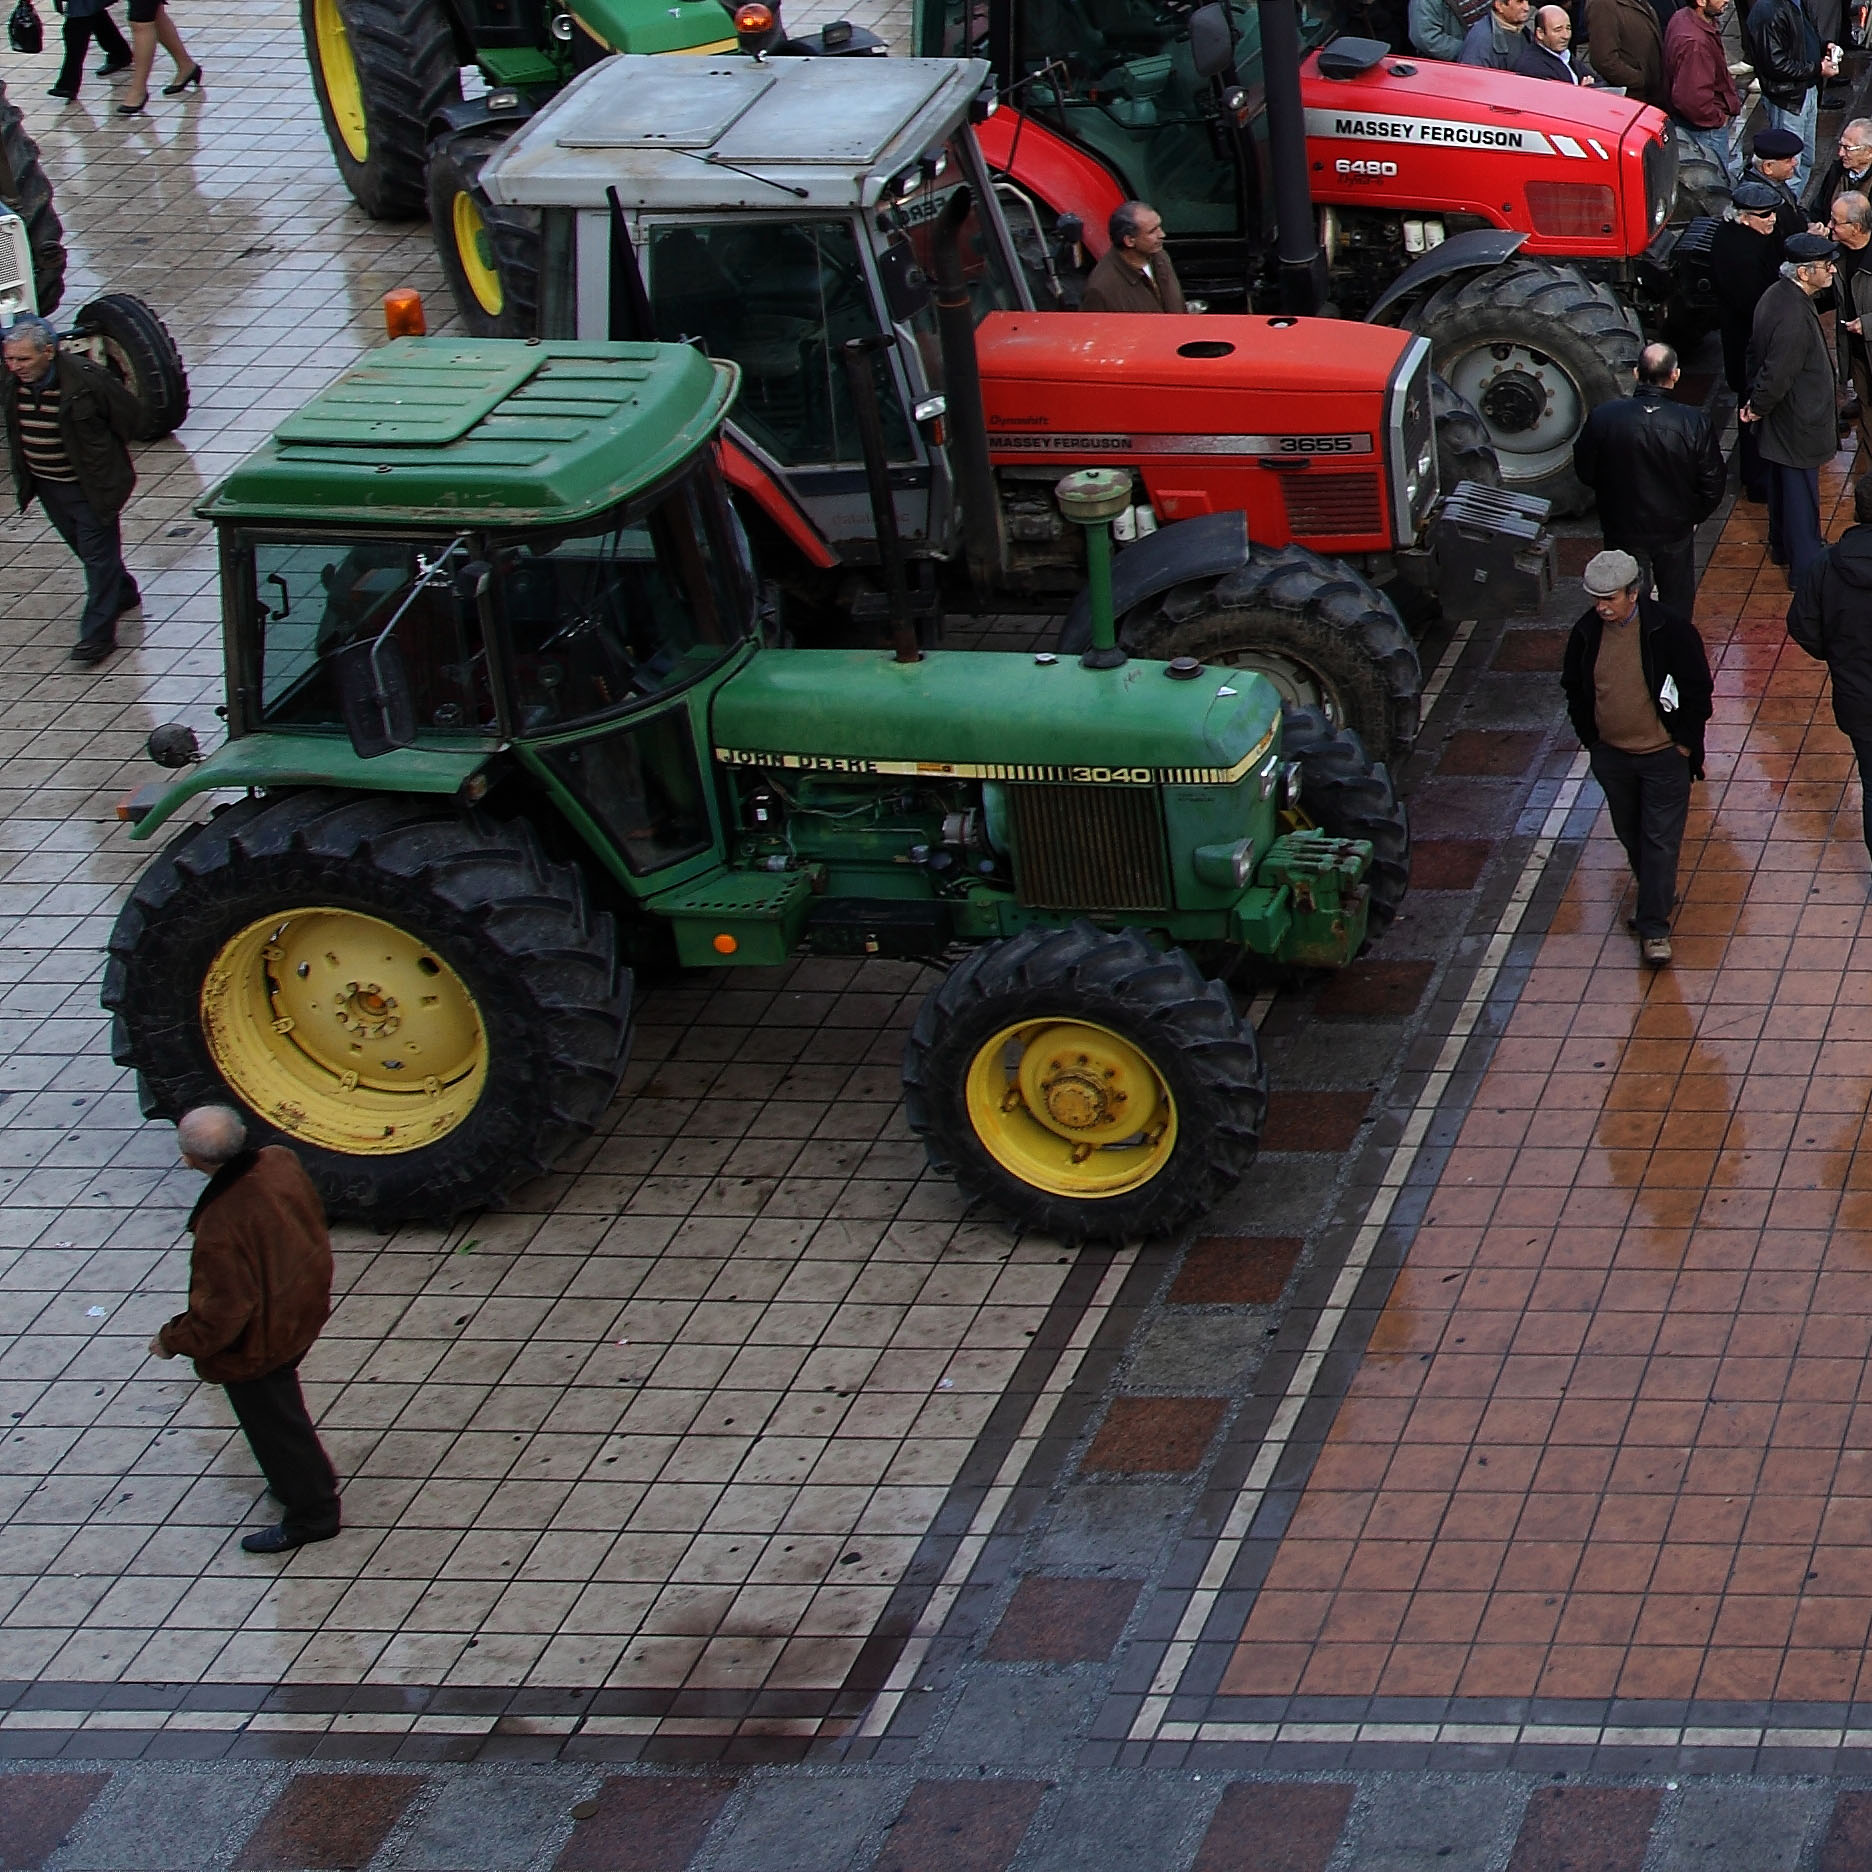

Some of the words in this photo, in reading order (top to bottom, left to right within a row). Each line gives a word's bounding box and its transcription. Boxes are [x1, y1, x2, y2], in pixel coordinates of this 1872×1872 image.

[1335, 119, 1417, 142] MASSEY
[1420, 123, 1523, 148] FERGUSON
[1335, 159, 1398, 176] 6480
[989, 437, 1050, 449] MASSEY
[1052, 437, 1132, 450] FERGUSON
[1280, 437, 1352, 453] 3655
[724, 748, 782, 766] JOHN
[803, 755, 883, 773] DEERE
[1073, 767, 1151, 783] 3040
